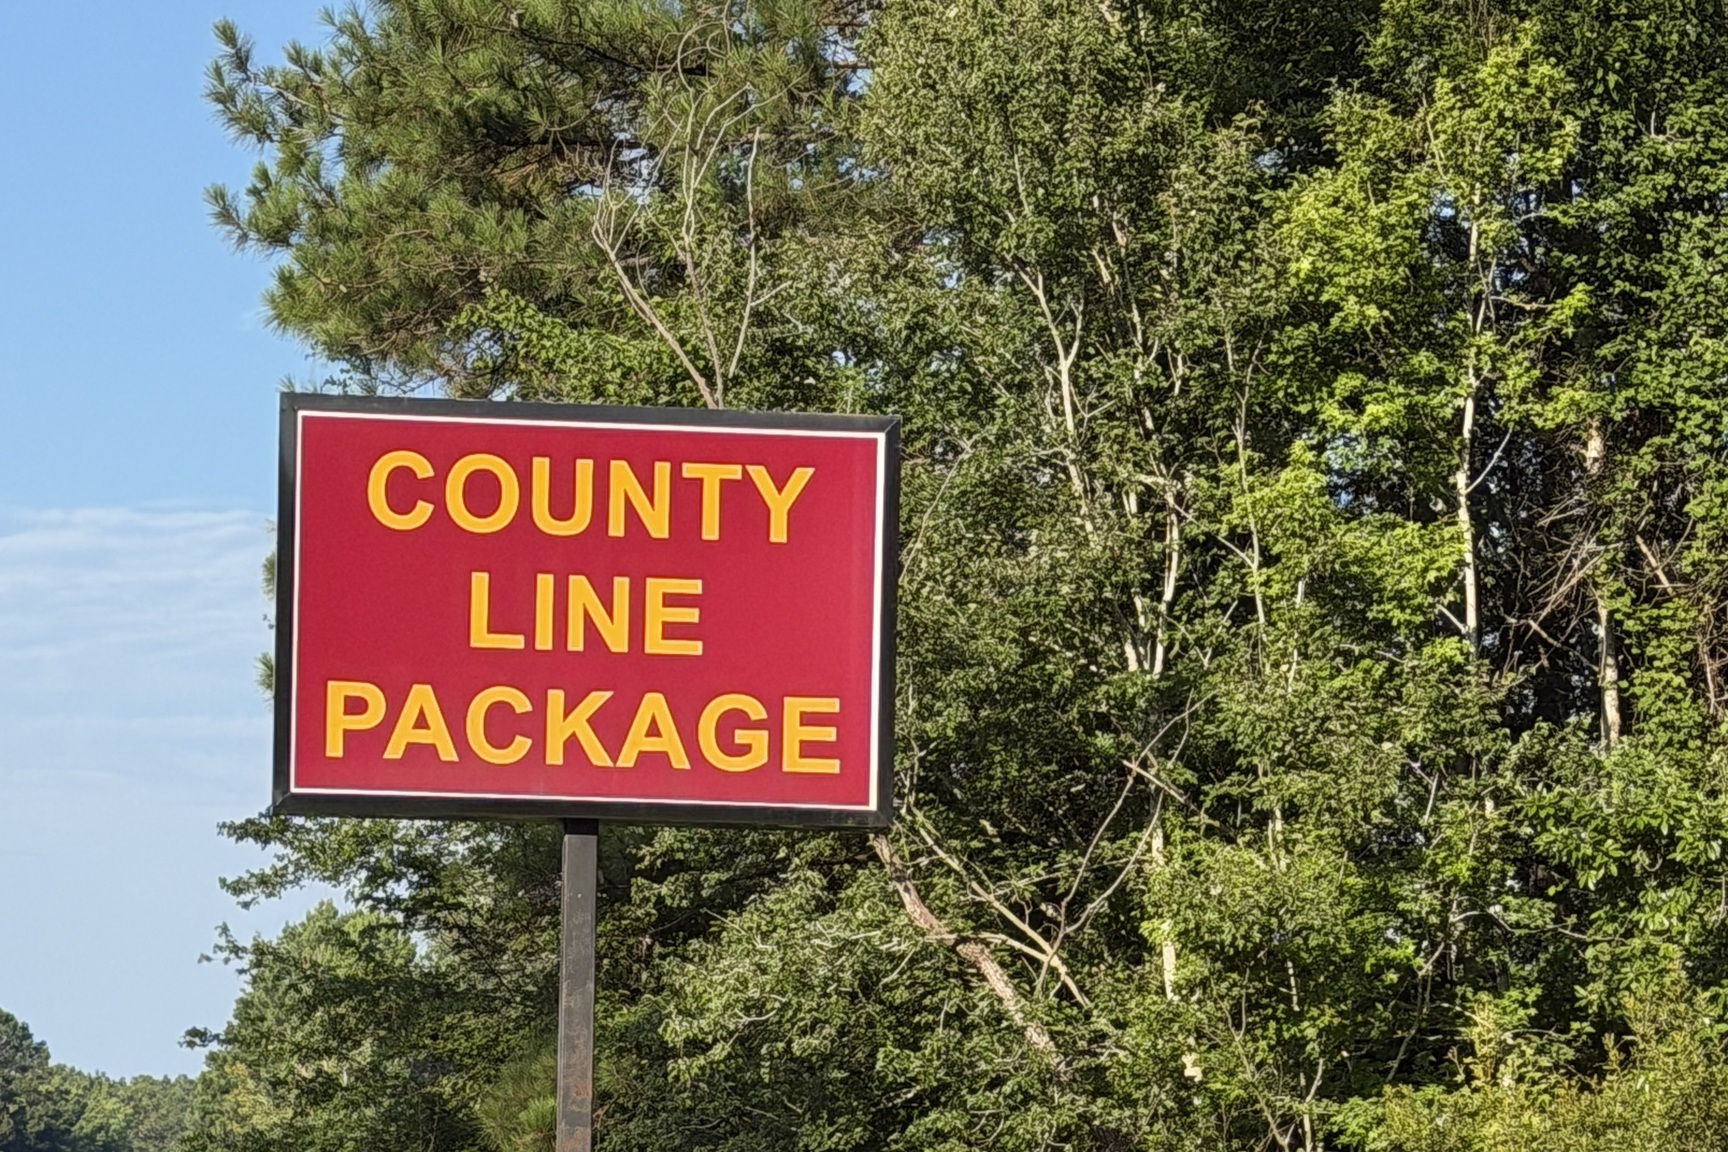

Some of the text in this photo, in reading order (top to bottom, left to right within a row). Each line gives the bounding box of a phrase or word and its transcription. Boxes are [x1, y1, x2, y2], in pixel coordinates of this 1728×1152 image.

[366, 450, 815, 545] COUNTY
[467, 570, 704, 657] LINE
[324, 679, 842, 776] PACKAGE
